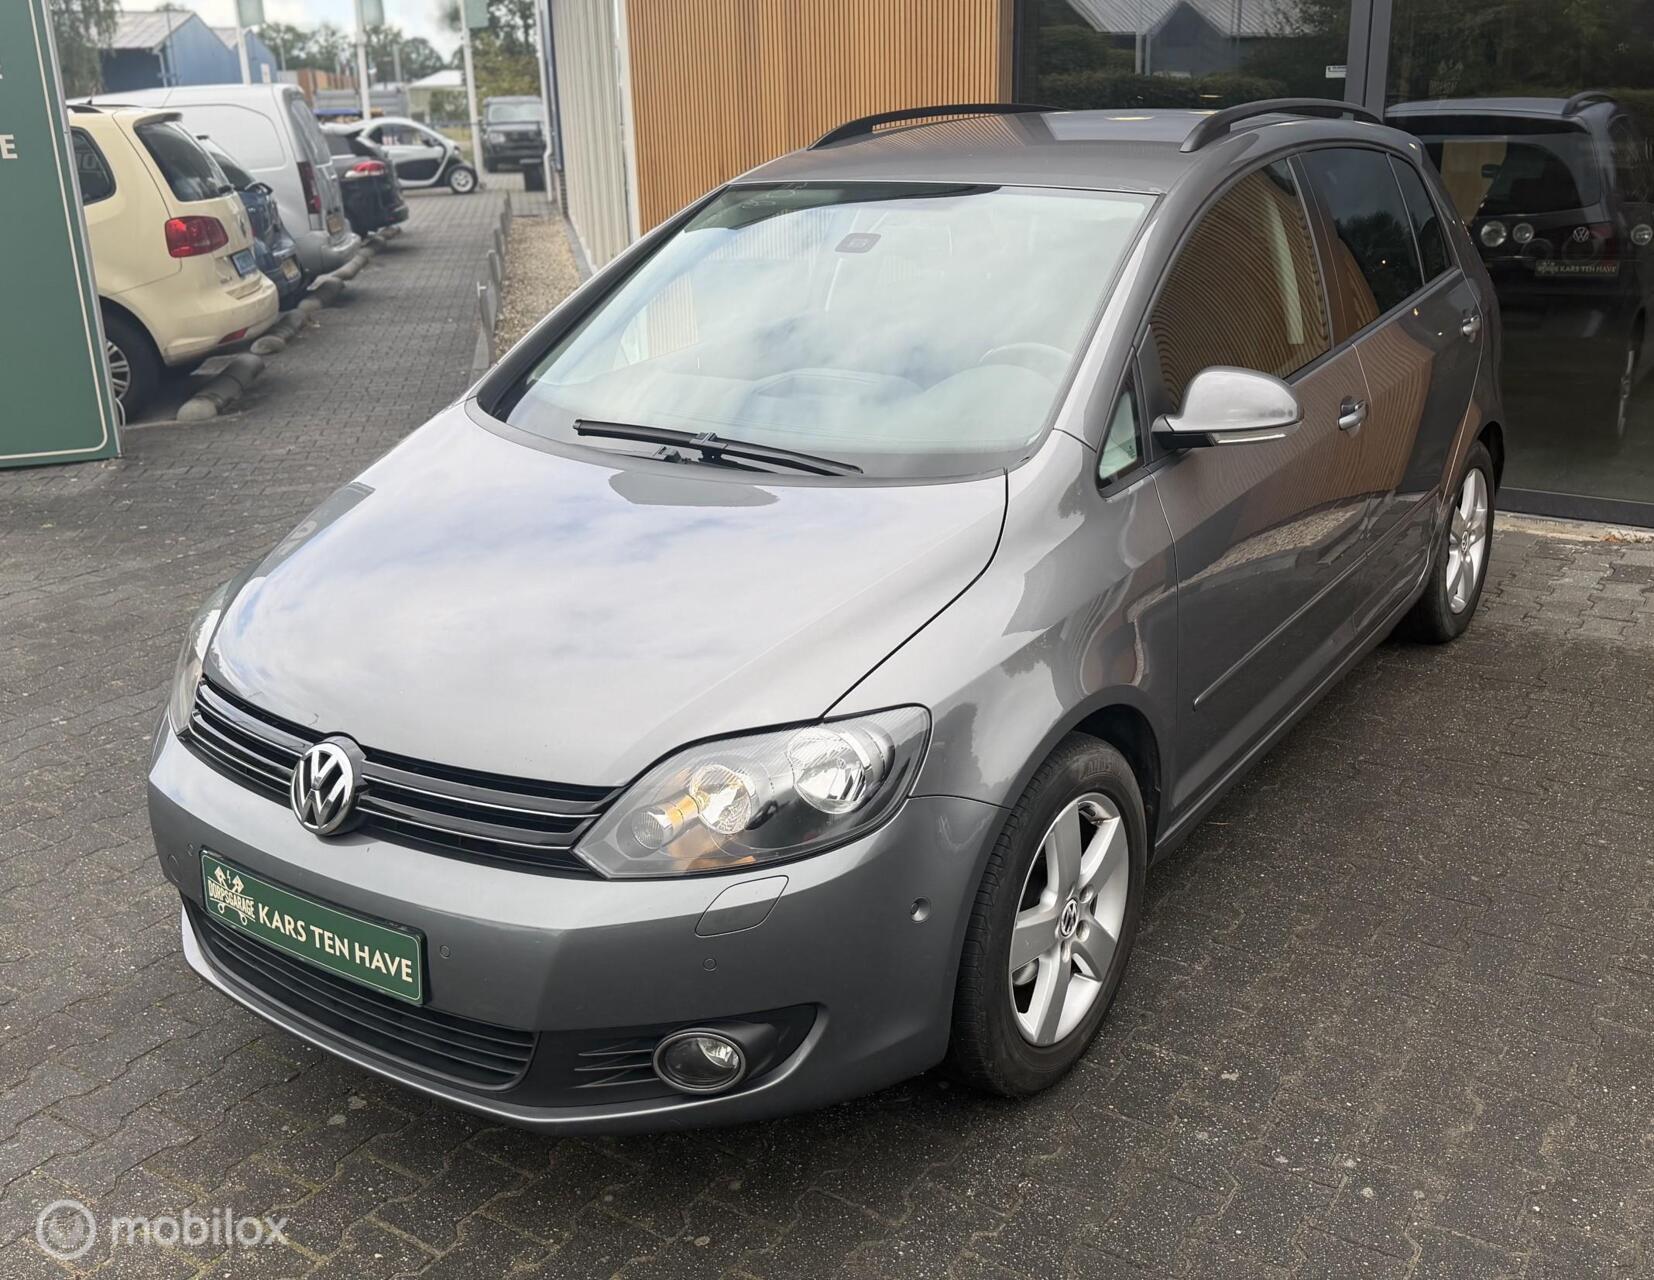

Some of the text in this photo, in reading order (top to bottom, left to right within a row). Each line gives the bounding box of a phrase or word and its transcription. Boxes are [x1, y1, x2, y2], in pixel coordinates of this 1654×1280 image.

[258, 902, 413, 983] KARS TEN HAVE
